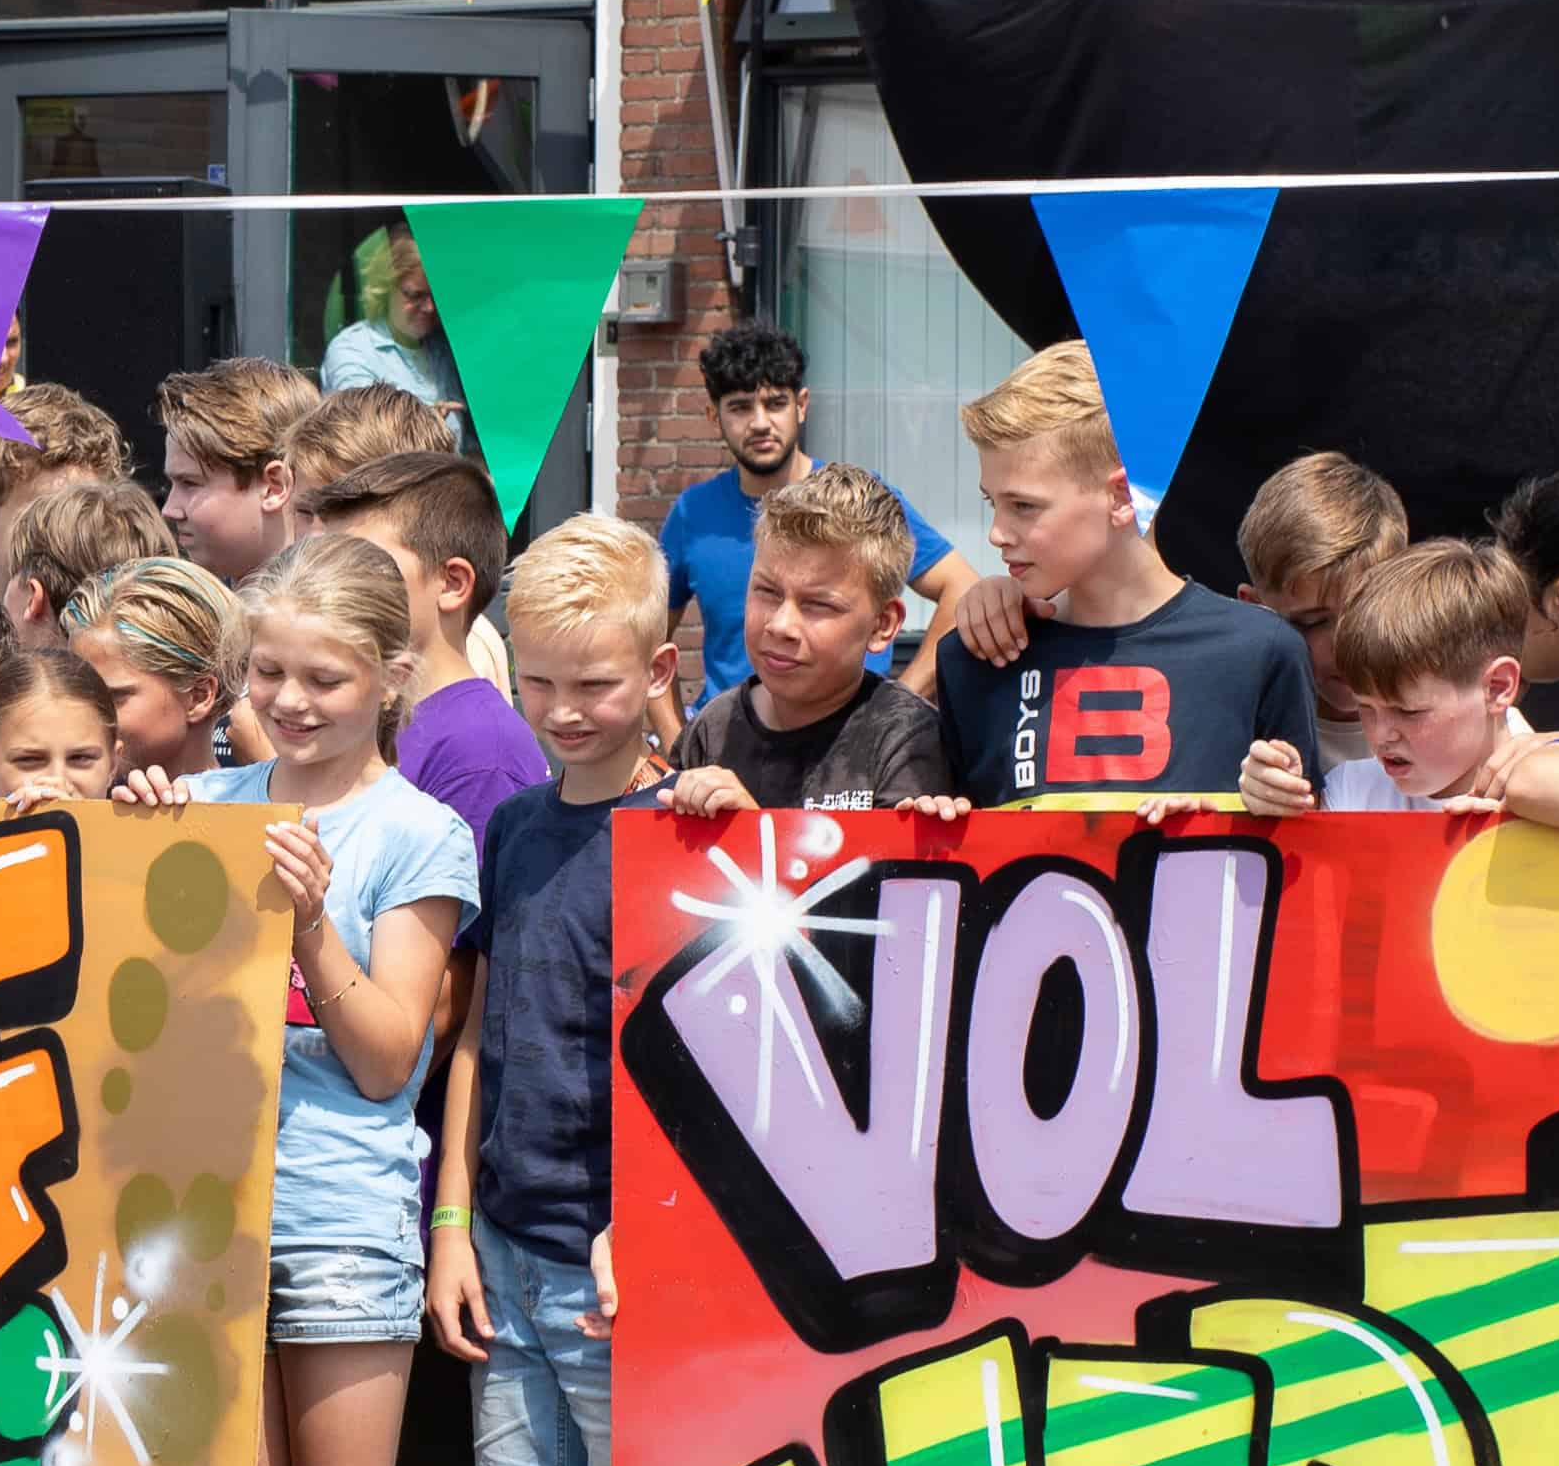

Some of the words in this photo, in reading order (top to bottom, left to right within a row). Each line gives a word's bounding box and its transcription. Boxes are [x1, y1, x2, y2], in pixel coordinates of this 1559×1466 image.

[1014, 669, 1041, 789] BOYS
[1045, 665, 1171, 783] B
[643, 839, 1352, 1313] VOL
